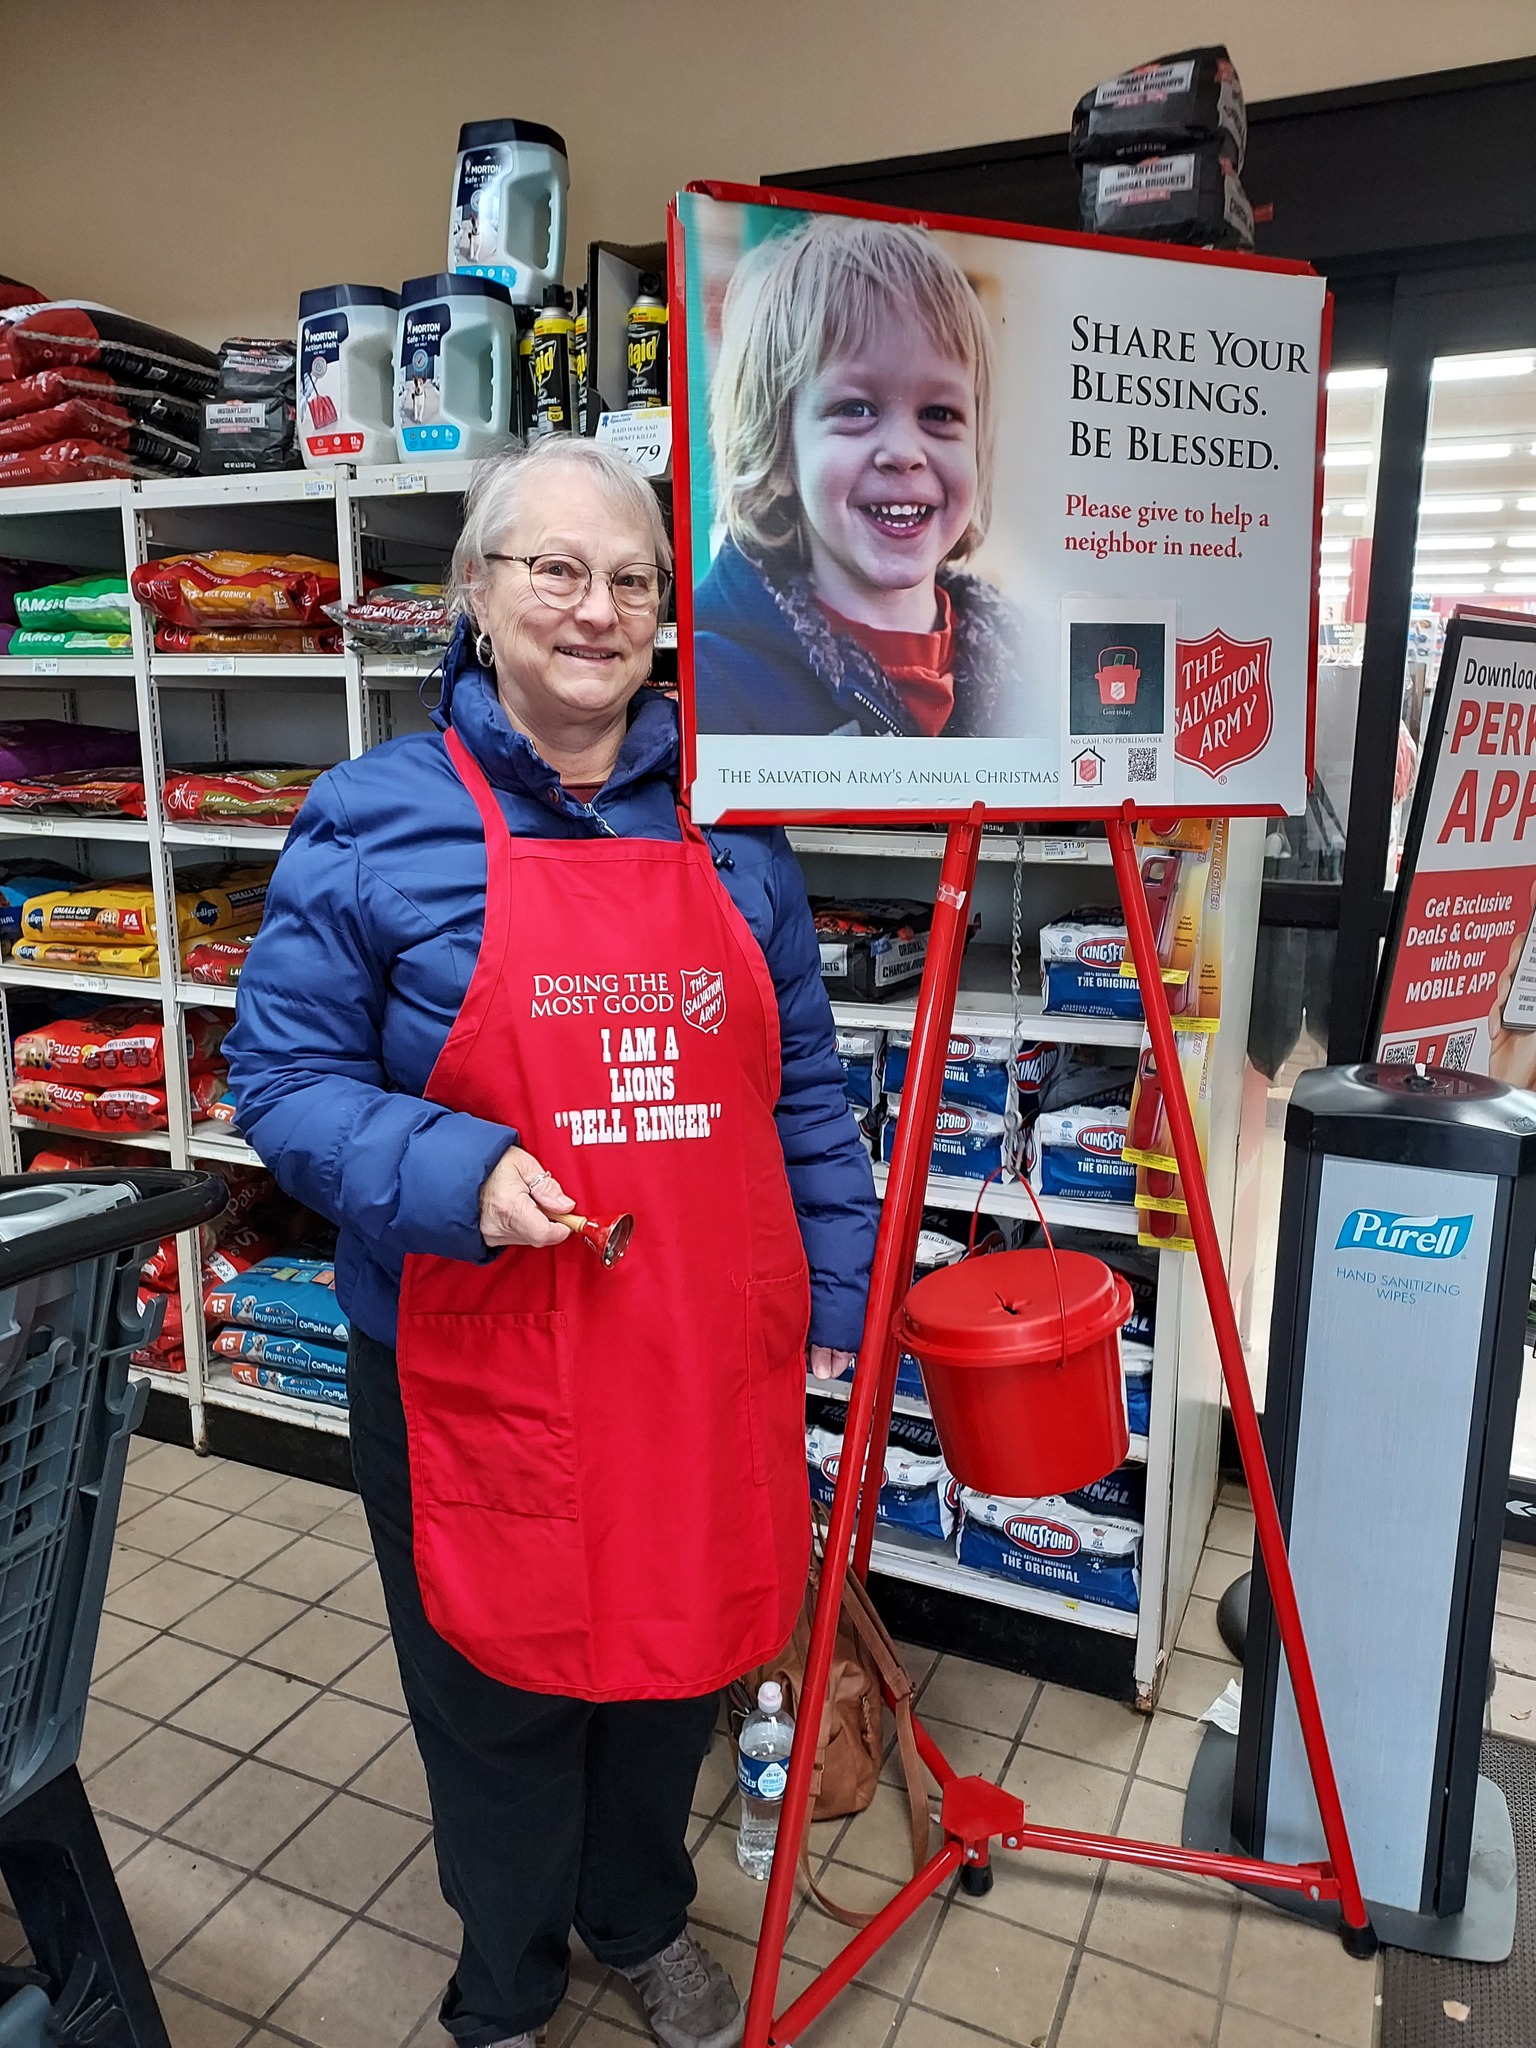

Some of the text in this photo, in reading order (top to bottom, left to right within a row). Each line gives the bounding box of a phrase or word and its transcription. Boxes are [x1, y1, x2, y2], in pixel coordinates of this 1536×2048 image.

[471, 164, 501, 174] MORTON
[310, 330, 338, 342] MORTON
[412, 322, 440, 335] MORTON
[305, 341, 337, 354] Action Melt
[1071, 315, 1311, 374] SHARE YOUR
[535, 347, 554, 378] aid
[1070, 363, 1267, 417] BLESSINGS.
[1069, 420, 1279, 471] BE BLESSED.
[1065, 494, 1270, 532] Please give to help a
[1065, 530, 1243, 559] neighbor in need.
[138, 581, 177, 600] ONE
[242, 634, 277, 642] FORMULA
[1182, 646, 1224, 691] THE
[1102, 708, 1115, 716] Give
[1199, 694, 1257, 759] ARMY
[718, 768, 751, 784] THE
[758, 768, 841, 784] SALVATION
[908, 769, 970, 784] ANNUAL
[975, 769, 1060, 784] CHRISTMAS
[168, 790, 199, 810] ONE
[1064, 841, 1084, 849] $11.99
[1210, 857, 1222, 910] LIGHTER
[1425, 892, 1513, 918] Get Exclusive
[123, 914, 138, 926] 14
[1406, 920, 1516, 947] Deals & Coupons
[1082, 942, 1126, 964] KINGSFO
[1430, 950, 1486, 973] with our
[533, 972, 670, 996] DOING THE
[690, 973, 708, 995] THE
[1078, 976, 1094, 988] THE
[1405, 971, 1497, 1004] MOBILE APP
[530, 994, 674, 1018] MOST GOOD
[684, 976, 722, 1017] SALVATION
[698, 996, 722, 1026] ARMY
[47, 1039, 82, 1058] Paws
[600, 1026, 680, 1063] I AM A
[46, 1083, 84, 1102] Paws
[610, 1066, 675, 1104] LIONS
[214, 1108, 230, 1120] 15
[554, 1102, 722, 1146] "BELL RINGER"
[934, 1142, 966, 1156] RIGINAL
[1082, 1130, 1126, 1150] KINGSFO
[1078, 1161, 1136, 1176] THE ORIGINA
[1352, 1211, 1460, 1257] Purell
[1336, 1266, 1461, 1297] HAND SANITIZING
[212, 1299, 226, 1314] 15
[1376, 1288, 1417, 1305] WIPES
[300, 1320, 332, 1334] Complete
[220, 1337, 236, 1351] 15
[266, 1350, 286, 1363] PUPPY
[238, 1370, 252, 1383] 15
[312, 1360, 346, 1374] Complete
[323, 1390, 348, 1400] Compl
[899, 1494, 906, 1502] 4
[1010, 1522, 1074, 1551] KINGSFORD
[1002, 1552, 1080, 1584] THE ORIGINAL
[1024, 1554, 1042, 1564] NATURAL
[1043, 1560, 1072, 1570] INGREDIENTS
[1093, 1562, 1100, 1570] 4
